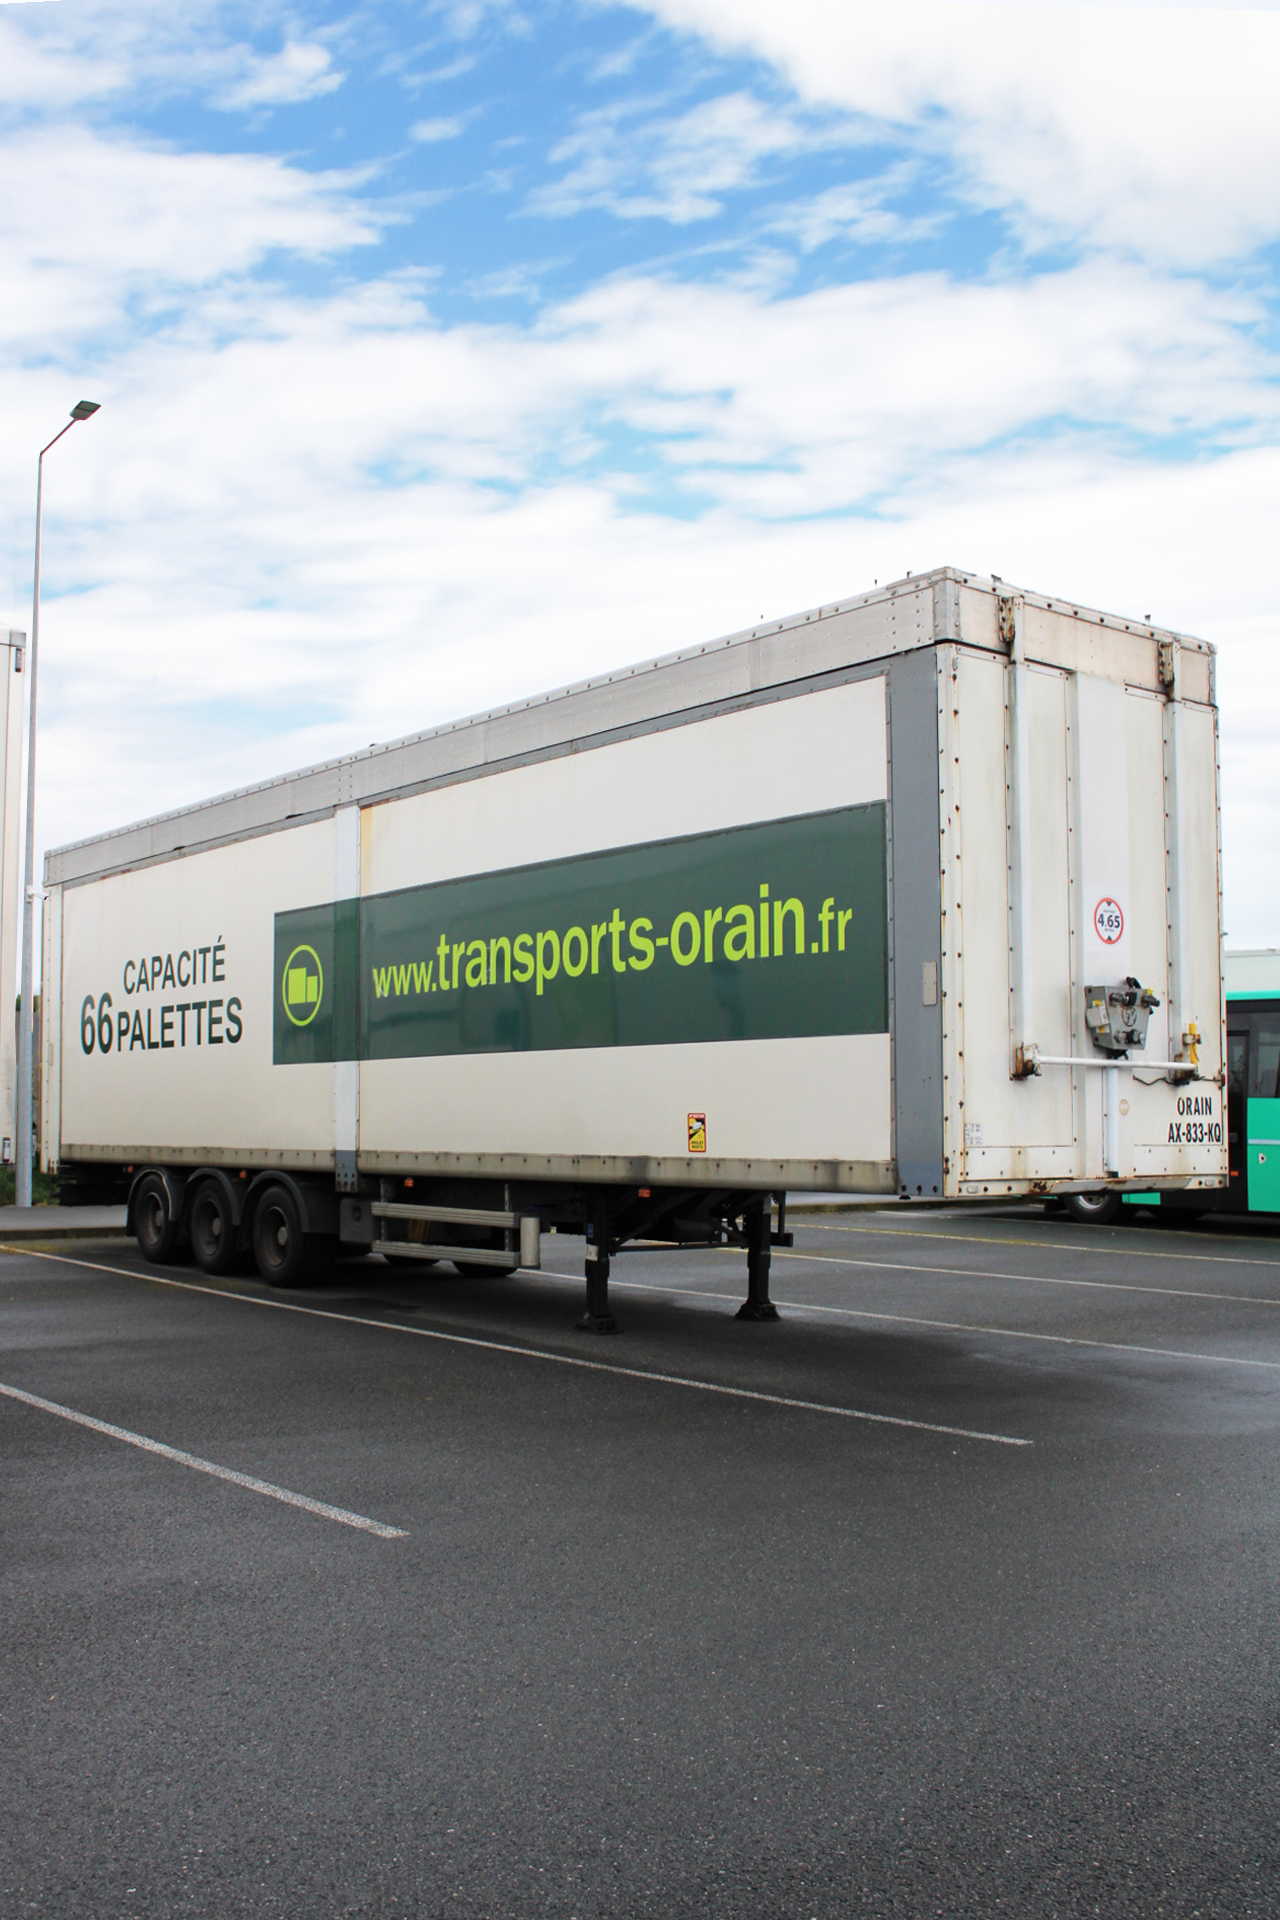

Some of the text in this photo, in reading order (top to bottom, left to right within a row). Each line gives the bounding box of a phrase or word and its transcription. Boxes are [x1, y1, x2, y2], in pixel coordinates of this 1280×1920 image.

[373, 883, 852, 998] www.transports-orain.fr
[1097, 913, 1121, 929] 4.65
[123, 935, 227, 995] CAPACITÉ
[80, 992, 243, 1055] 66 PALETTES
[1177, 1097, 1212, 1116] ORAIN
[1168, 1123, 1221, 1143] AX-833-KQ
